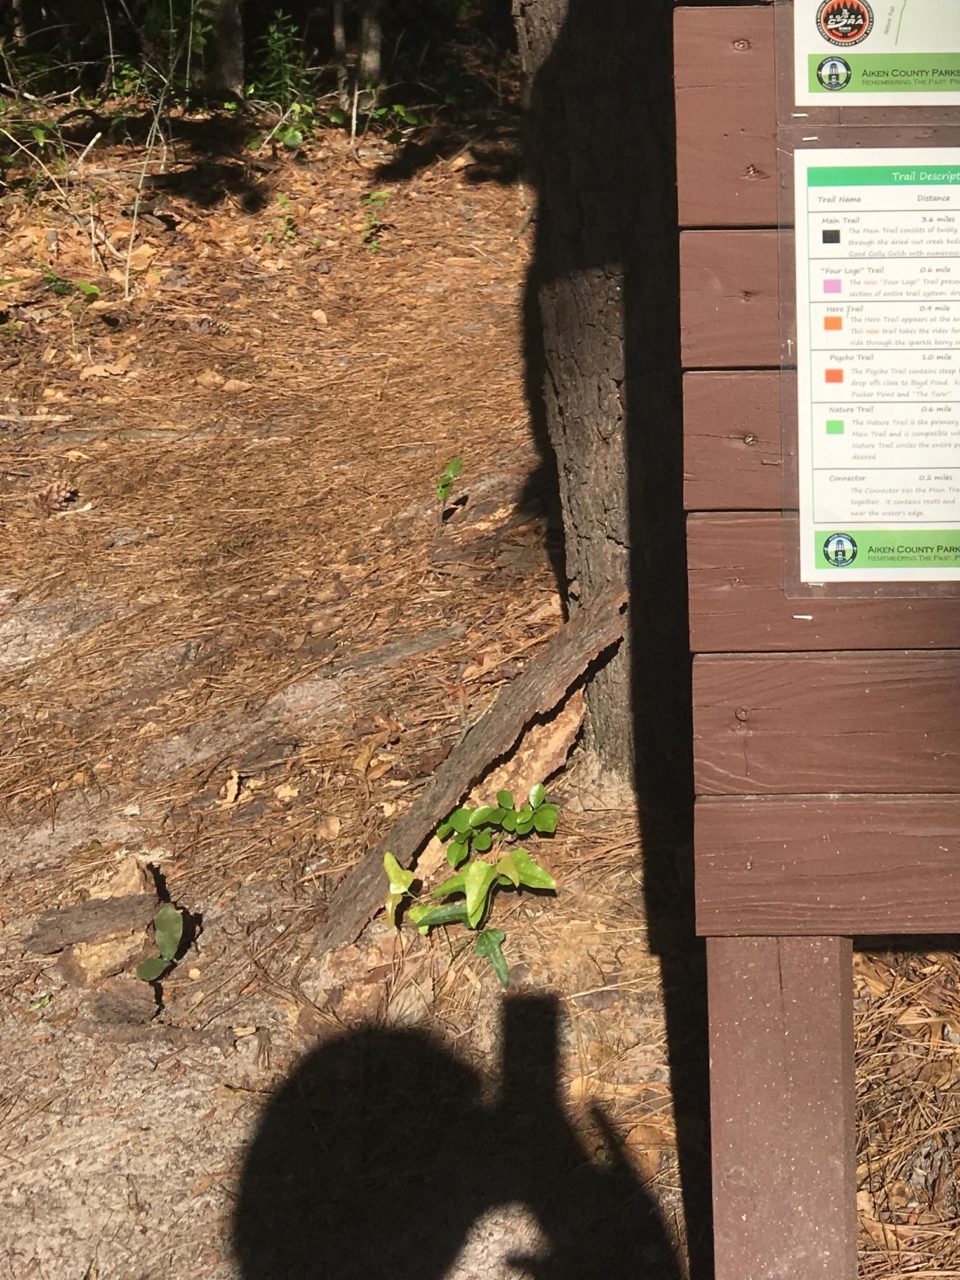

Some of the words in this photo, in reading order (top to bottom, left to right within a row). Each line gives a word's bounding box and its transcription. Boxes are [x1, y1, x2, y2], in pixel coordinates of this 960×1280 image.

[891, 69, 929, 77] COUNTY
[892, 172, 916, 181] Trail
[917, 194, 951, 202] Distance
[846, 305, 863, 314] Trail
[829, 354, 854, 363] Psycho
[829, 406, 854, 414] Nature
[868, 546, 894, 554] AIKEN
